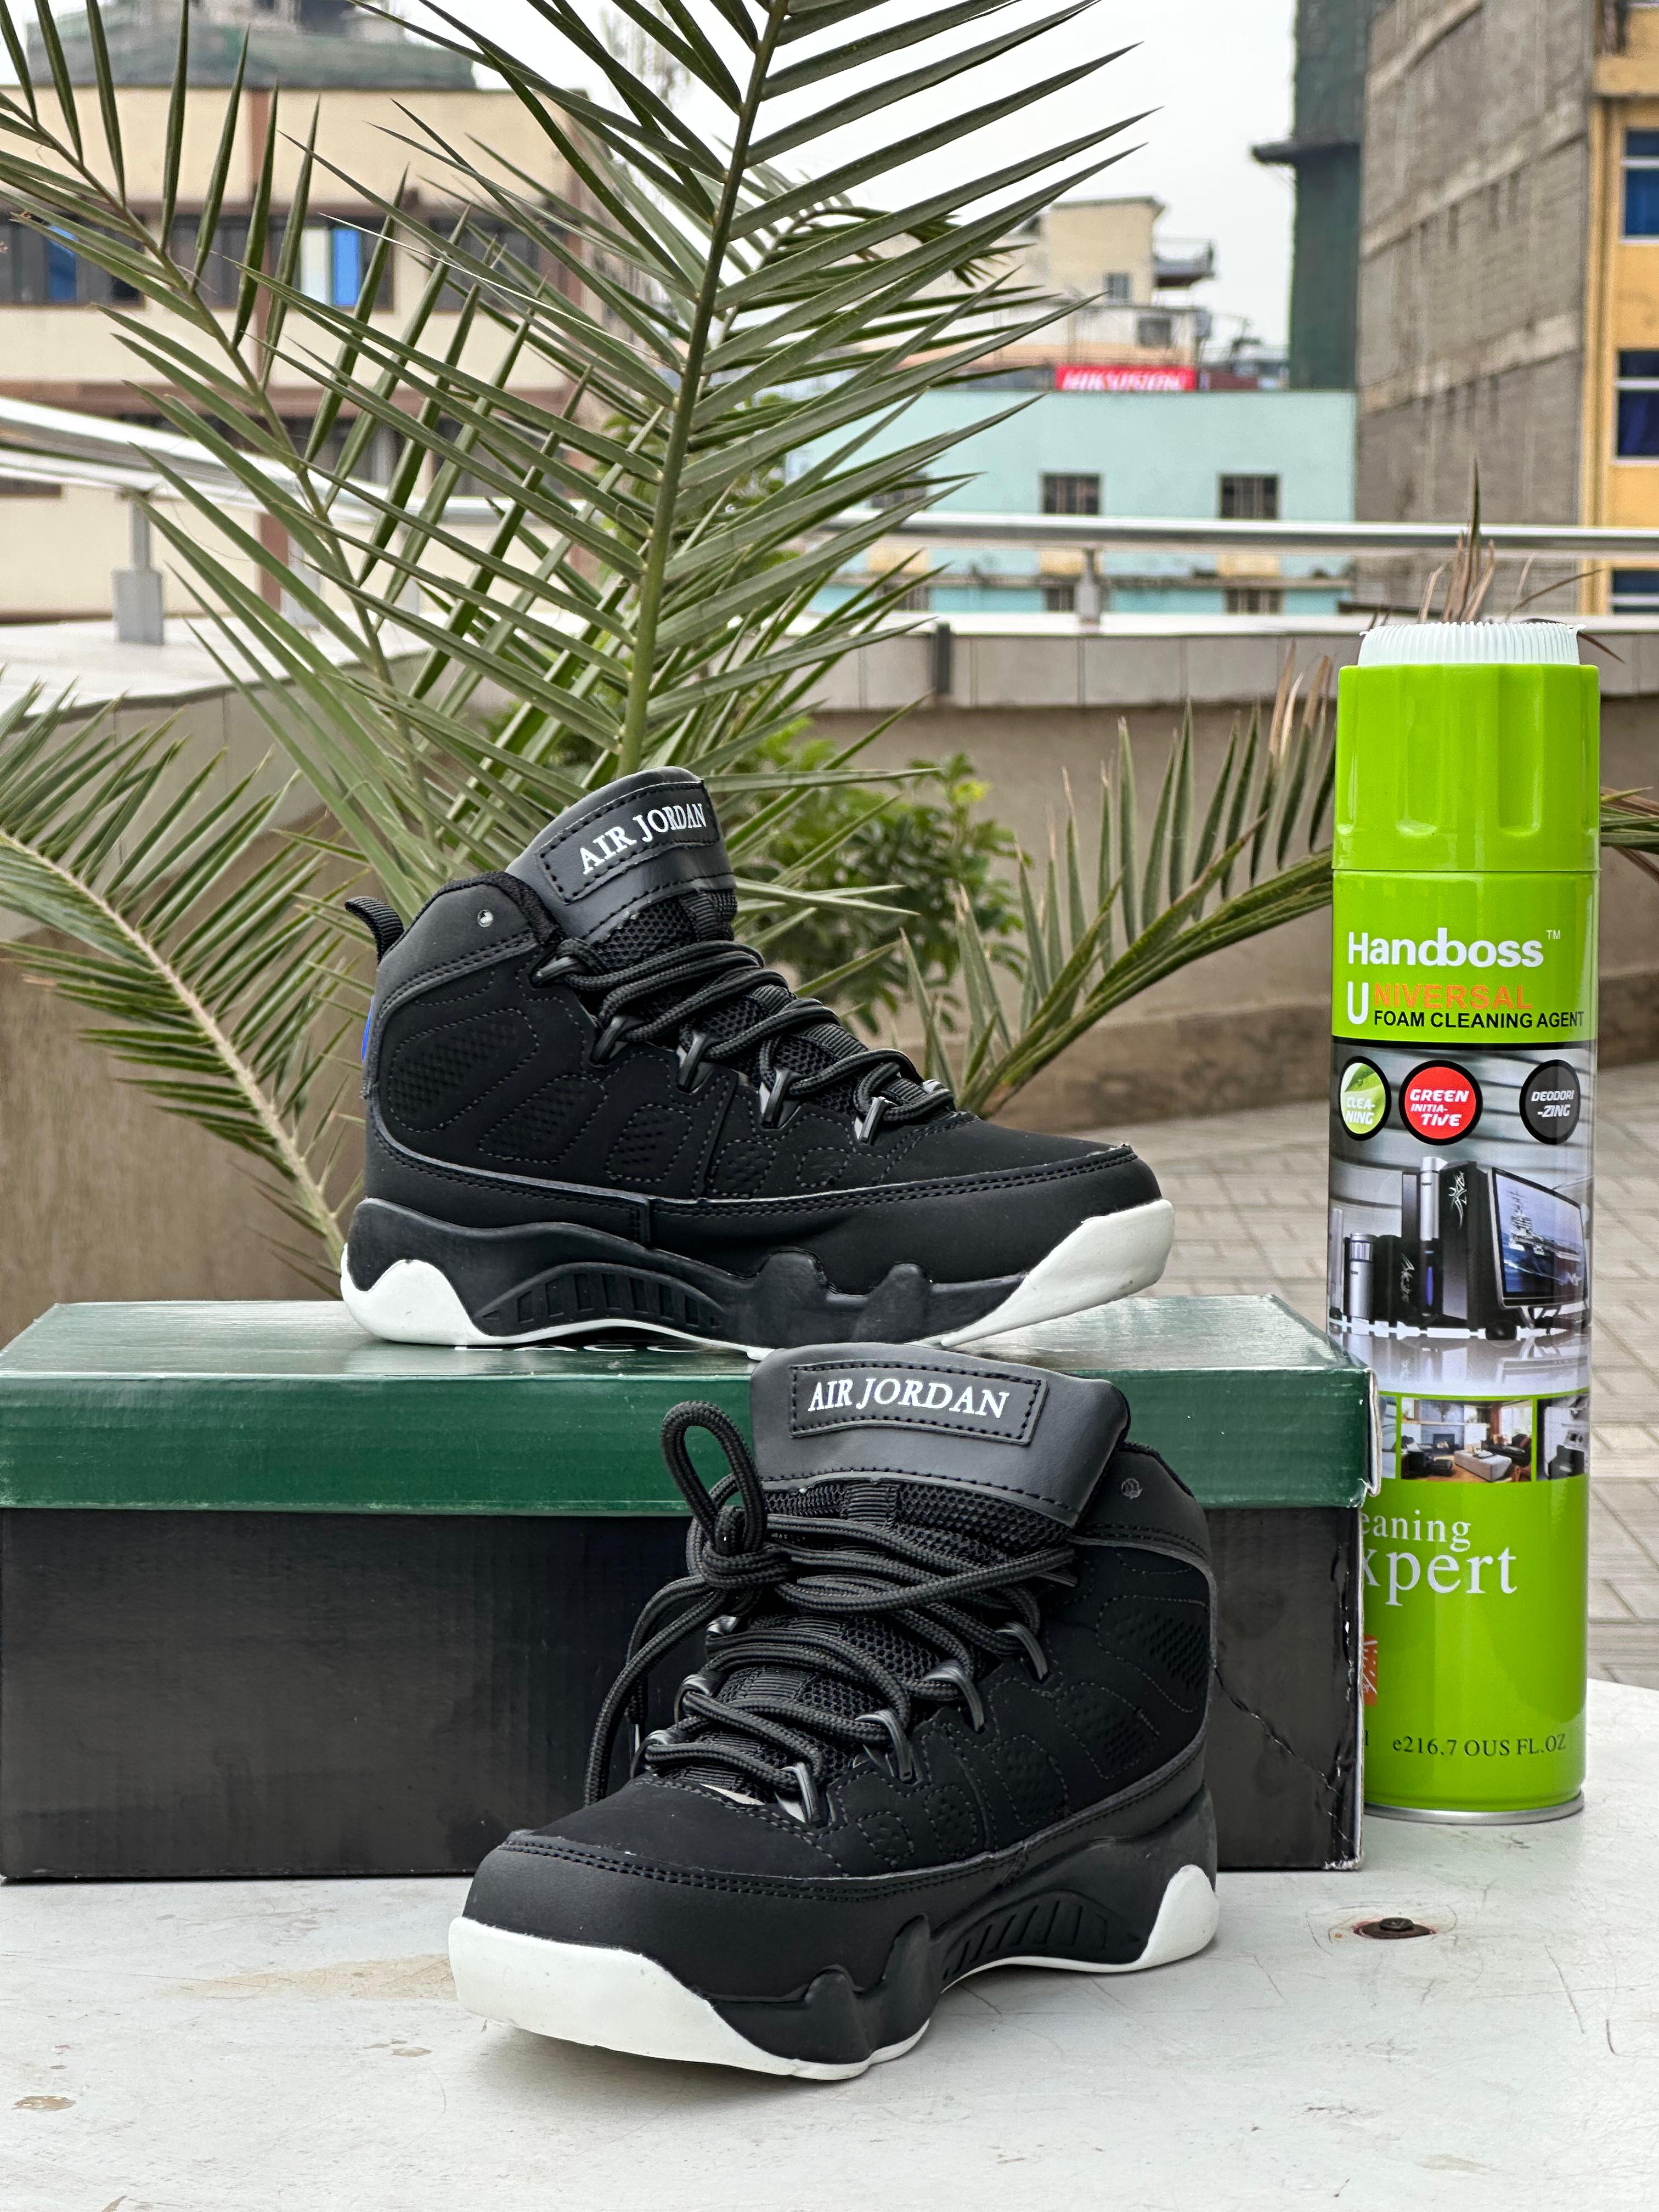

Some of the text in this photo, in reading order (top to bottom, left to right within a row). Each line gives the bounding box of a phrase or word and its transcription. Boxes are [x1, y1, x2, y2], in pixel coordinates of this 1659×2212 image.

[579, 803, 707, 876] AIR JORDAN
[1347, 927, 1561, 968] Handboss TM
[1374, 1010, 1584, 1029] FOAM CLEANING AGENT
[1409, 1089, 1469, 1103] GREEN
[1345, 1110, 1375, 1125] NING
[1421, 1114, 1462, 1127] TIVE
[808, 1378, 1009, 1419] AIR JORDAN
